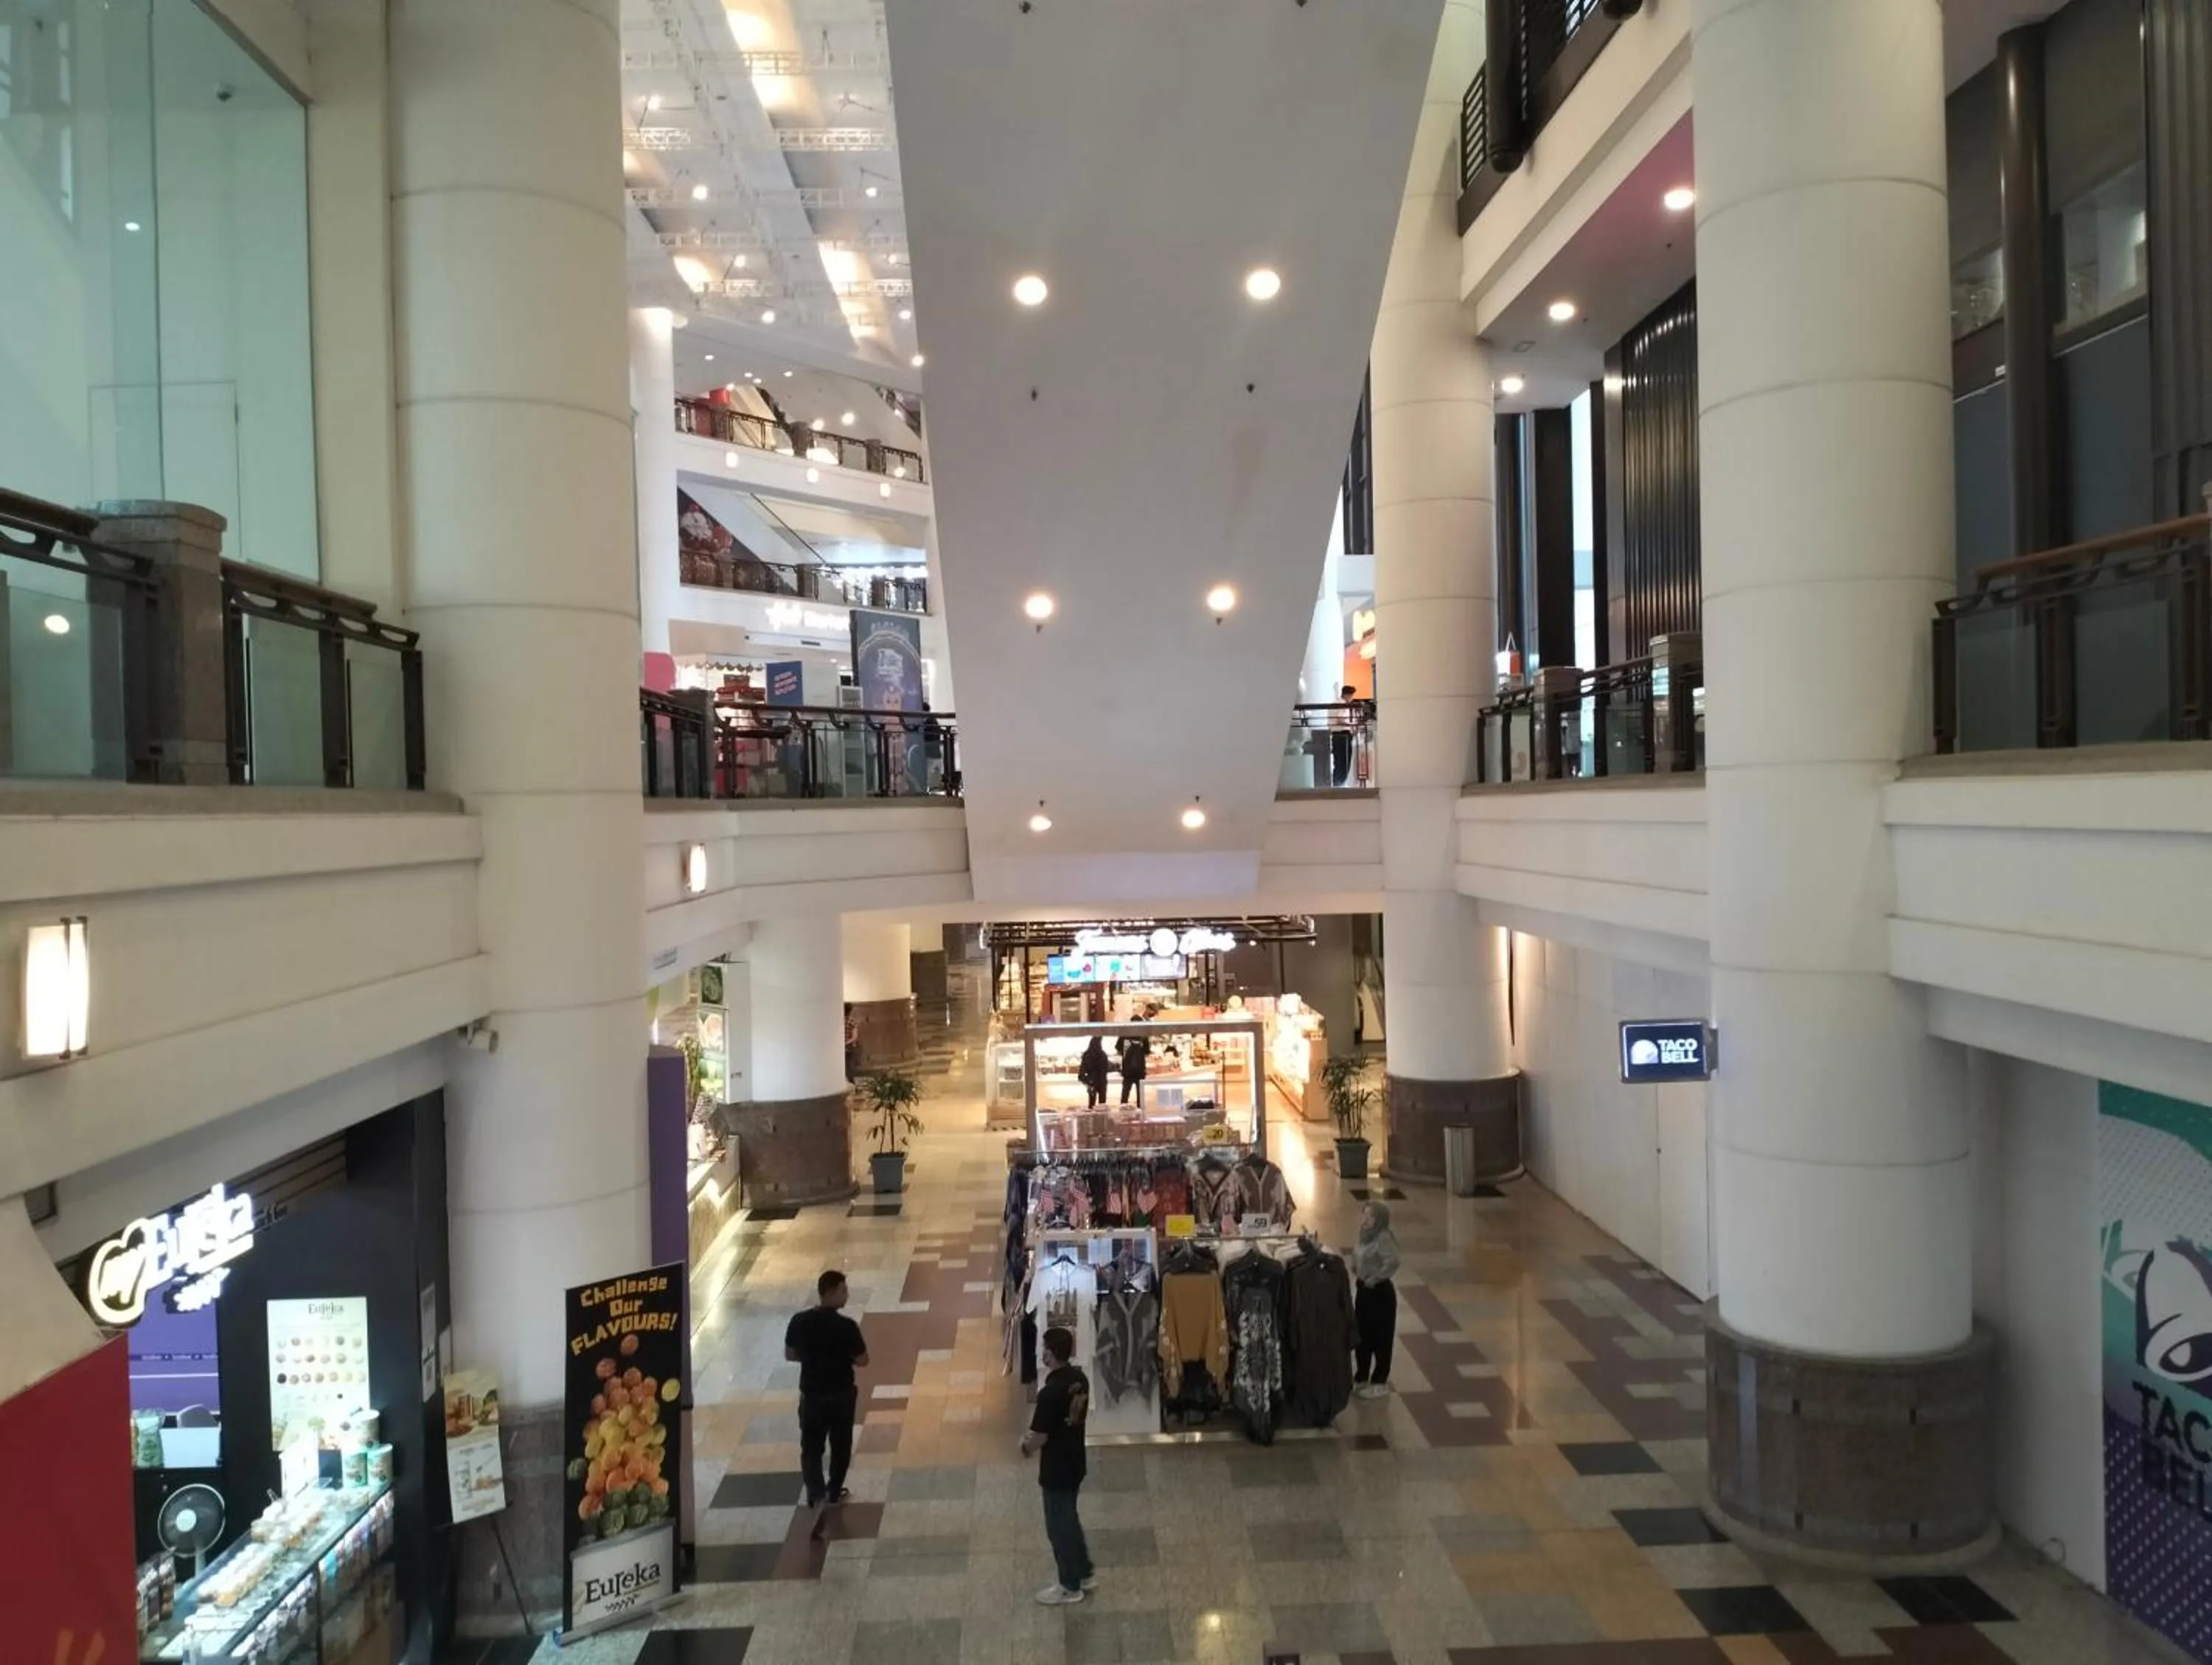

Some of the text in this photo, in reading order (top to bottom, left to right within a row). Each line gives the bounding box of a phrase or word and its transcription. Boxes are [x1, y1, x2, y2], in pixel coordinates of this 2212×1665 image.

[1658, 1037, 1698, 1052] TACO
[1660, 1050, 1700, 1063] BELL
[580, 1276, 668, 1307] Challenge
[609, 1299, 644, 1318] Our
[570, 1312, 678, 1357] FLAVOURS!
[2132, 1380, 2212, 1464] TAC
[2143, 1437, 2212, 1525] BEL
[585, 1561, 661, 1605] Eureka
